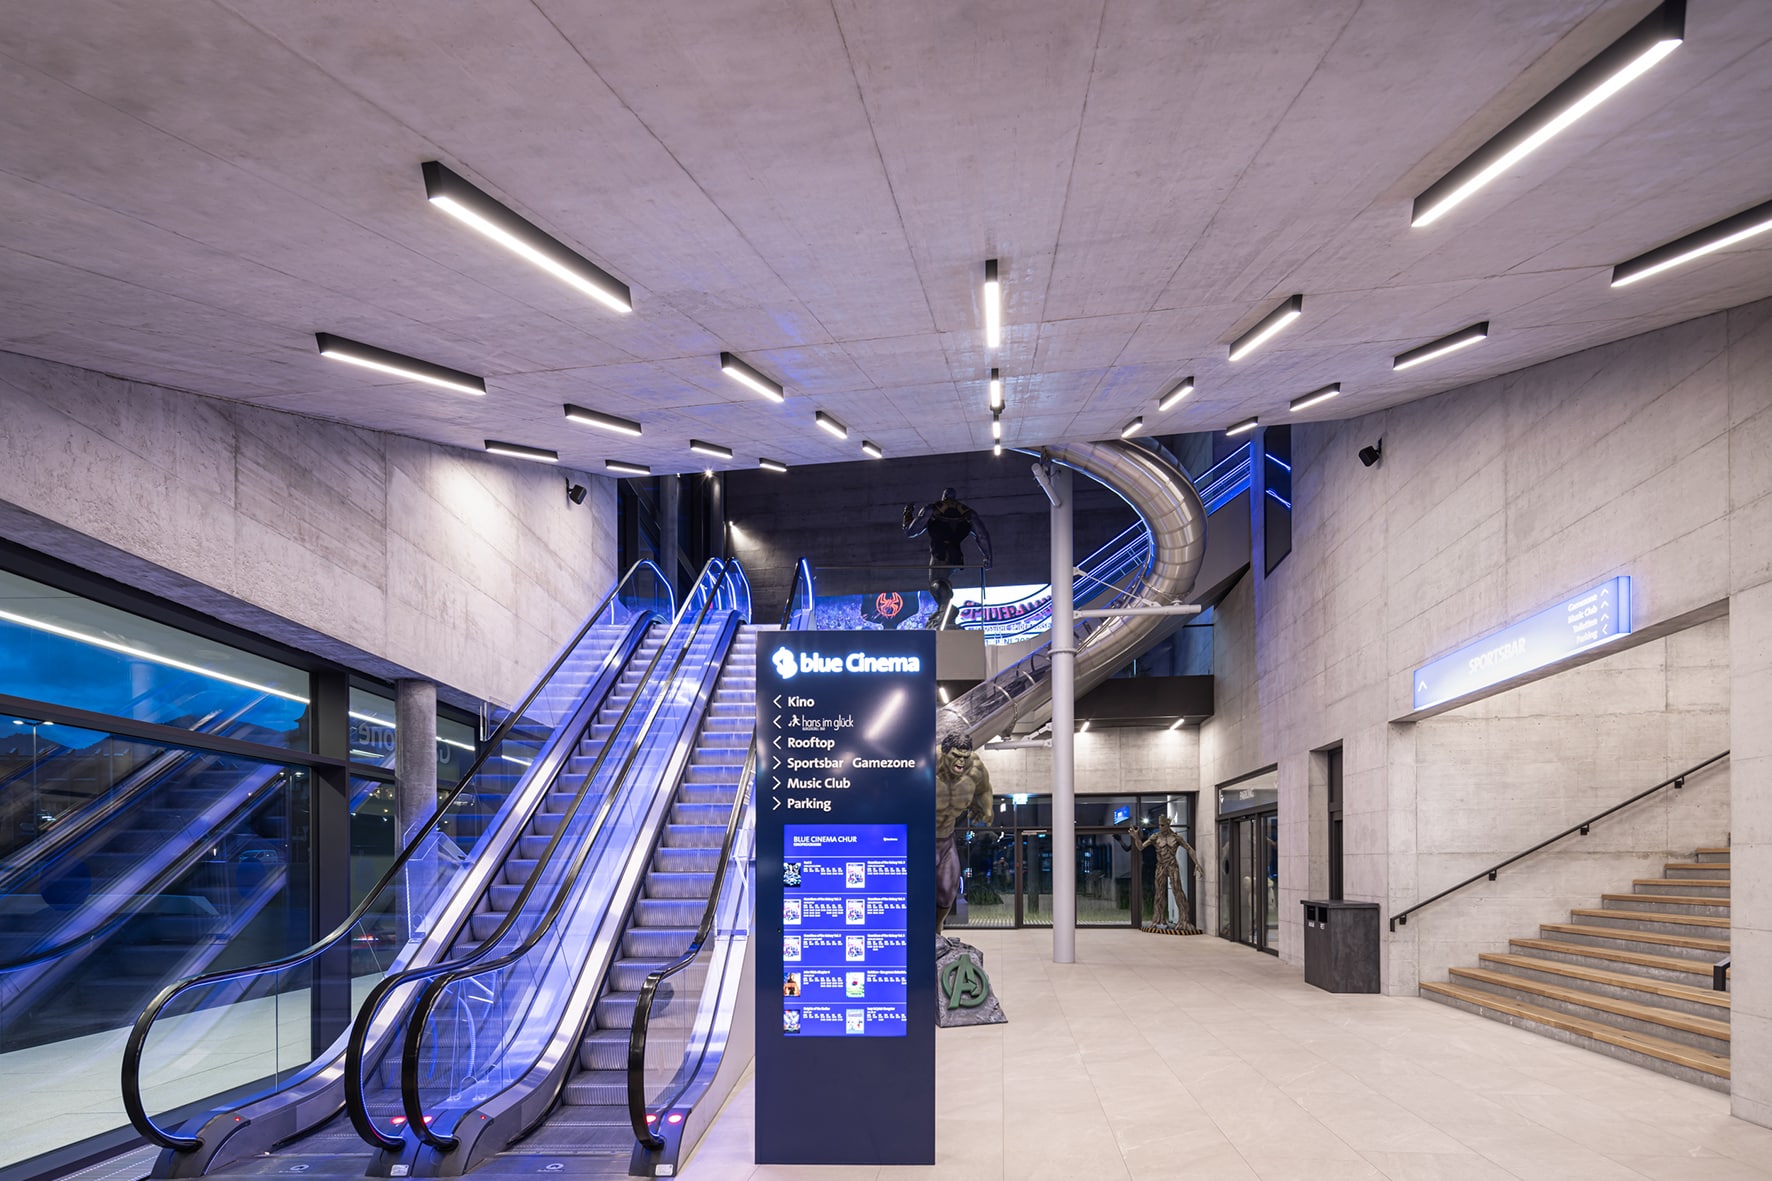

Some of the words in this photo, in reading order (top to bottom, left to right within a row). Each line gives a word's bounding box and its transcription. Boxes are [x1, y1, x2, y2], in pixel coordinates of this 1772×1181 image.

[800, 652, 843, 673] blue
[846, 652, 920, 673] Cinema
[1468, 637, 1527, 675] SPORTSBAR
[787, 696, 815, 708] Kino
[802, 714, 821, 728] hans
[822, 717, 833, 727] im
[833, 714, 854, 731] glück
[787, 738, 836, 750] Rooftop
[787, 757, 844, 771] Sportsbar
[852, 757, 916, 769] Gamezone
[787, 778, 822, 789] Music
[824, 777, 851, 789] Club
[787, 798, 832, 812] Parking
